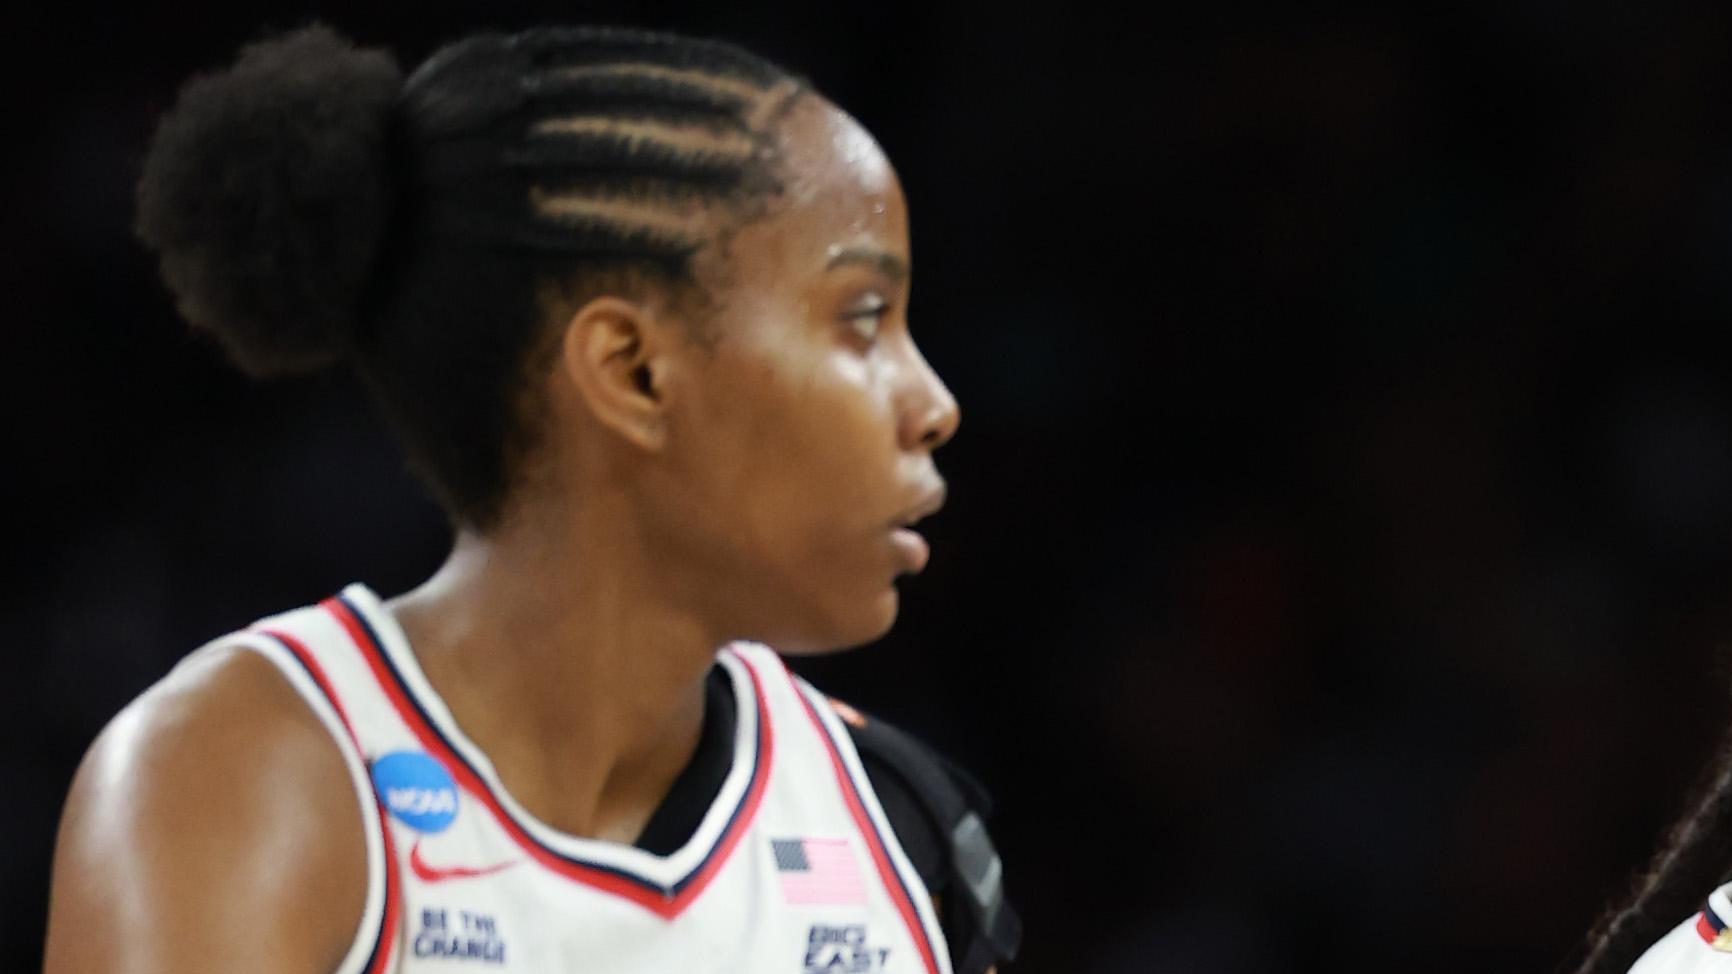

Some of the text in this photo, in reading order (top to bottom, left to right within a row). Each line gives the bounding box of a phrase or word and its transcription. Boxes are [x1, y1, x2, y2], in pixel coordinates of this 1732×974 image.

[386, 787, 456, 815] NCAA
[807, 923, 866, 945] BIG
[413, 934, 505, 964] CHANGE
[803, 945, 891, 973] EAST
